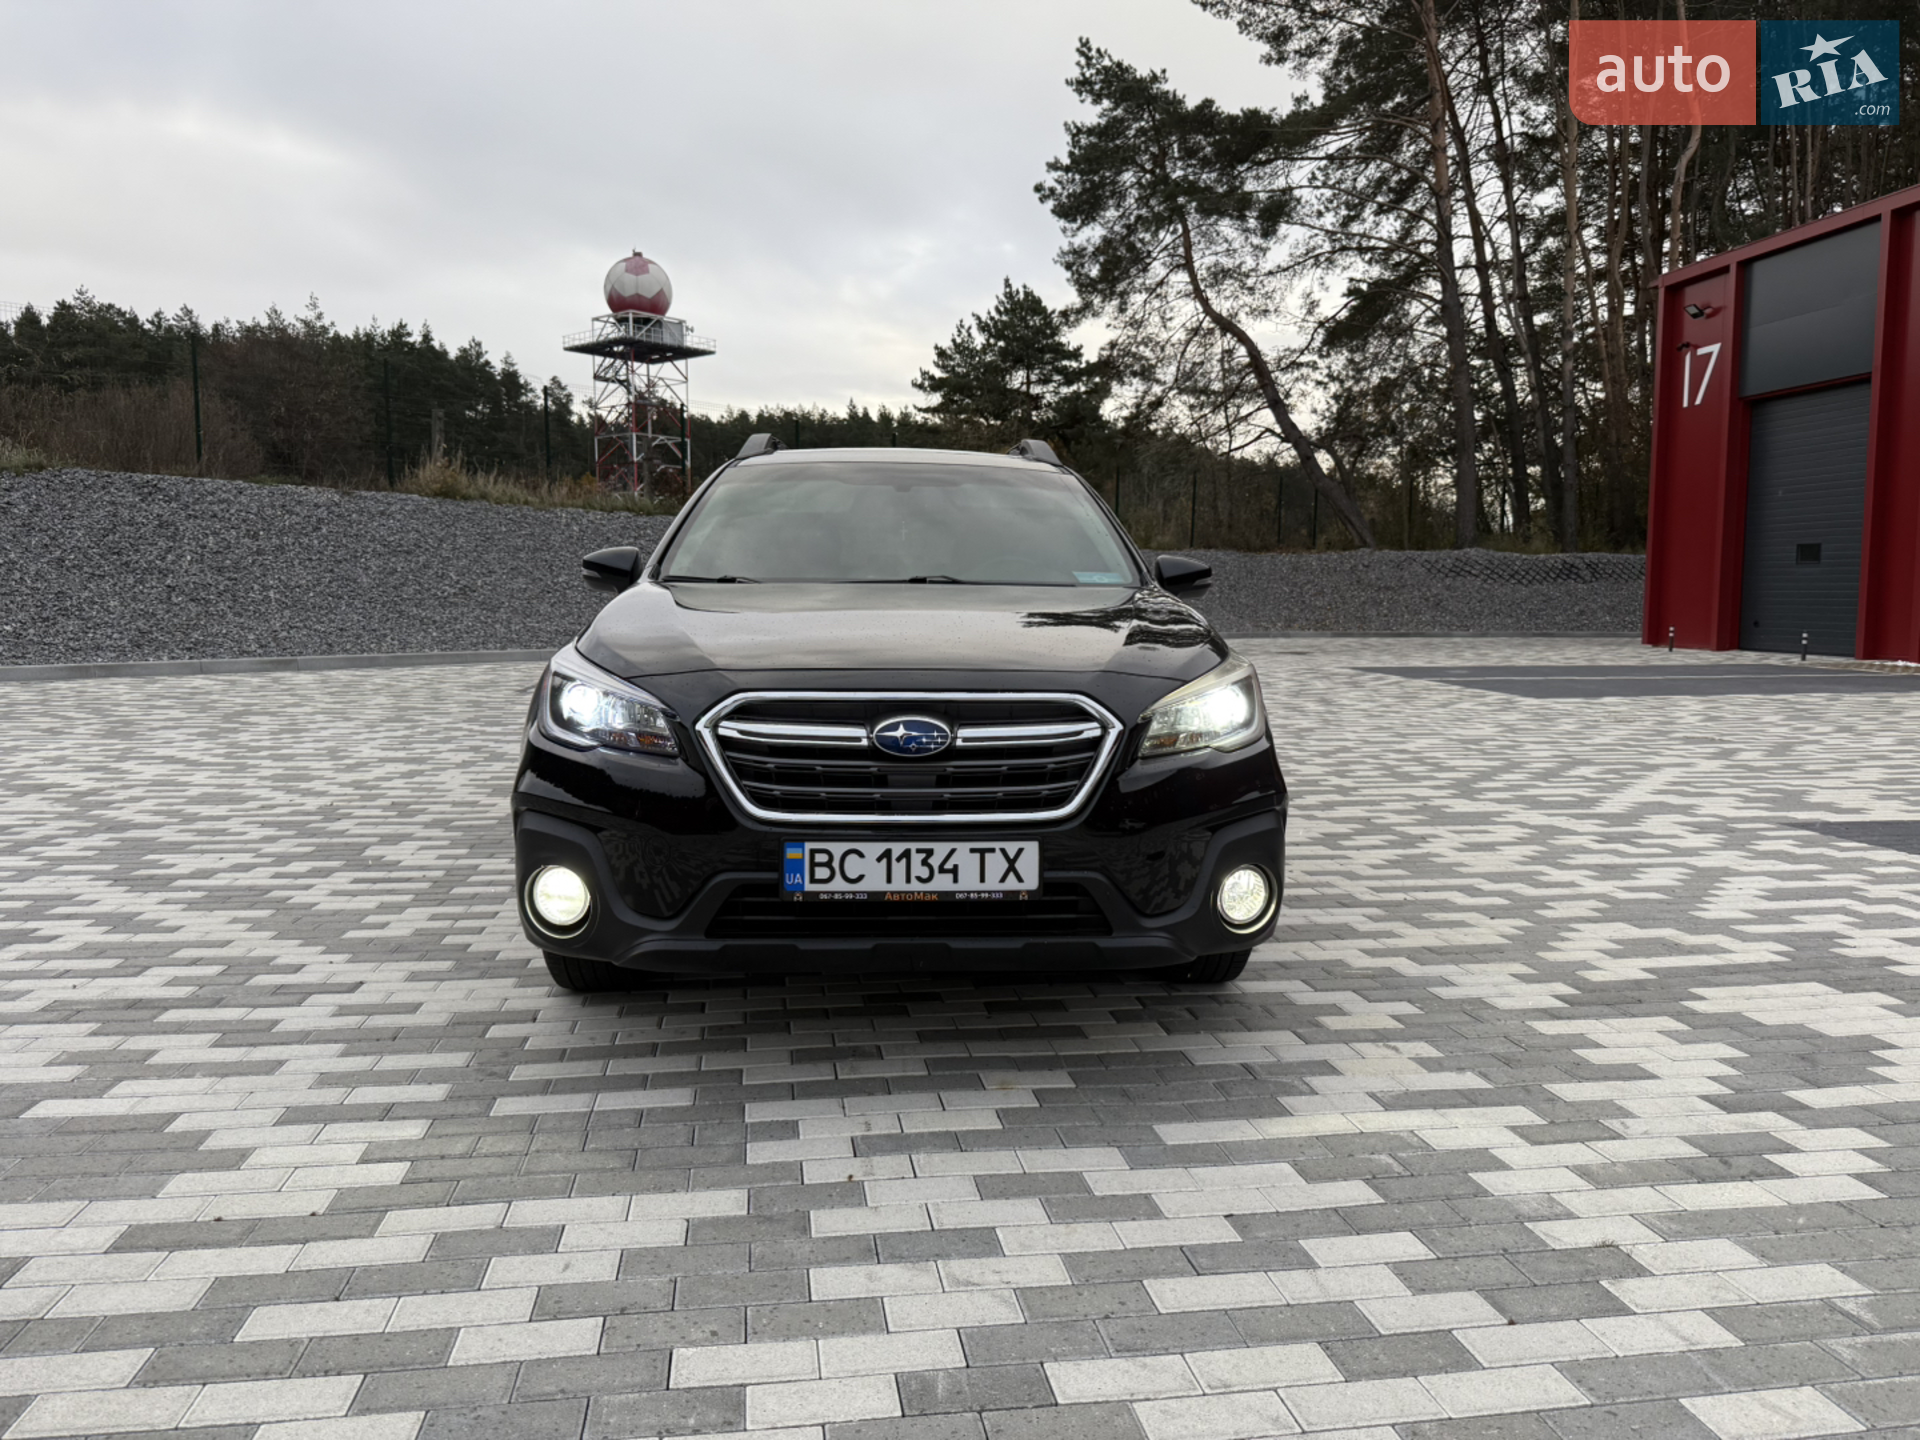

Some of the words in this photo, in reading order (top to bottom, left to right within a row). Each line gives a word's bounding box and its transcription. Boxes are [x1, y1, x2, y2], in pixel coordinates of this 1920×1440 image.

[1682, 342, 1722, 408] 17
[809, 848, 866, 884] BC
[875, 848, 959, 884] 1134
[969, 847, 1025, 884] TX
[785, 873, 803, 885] UA
[884, 891, 939, 901] АвтоМак
